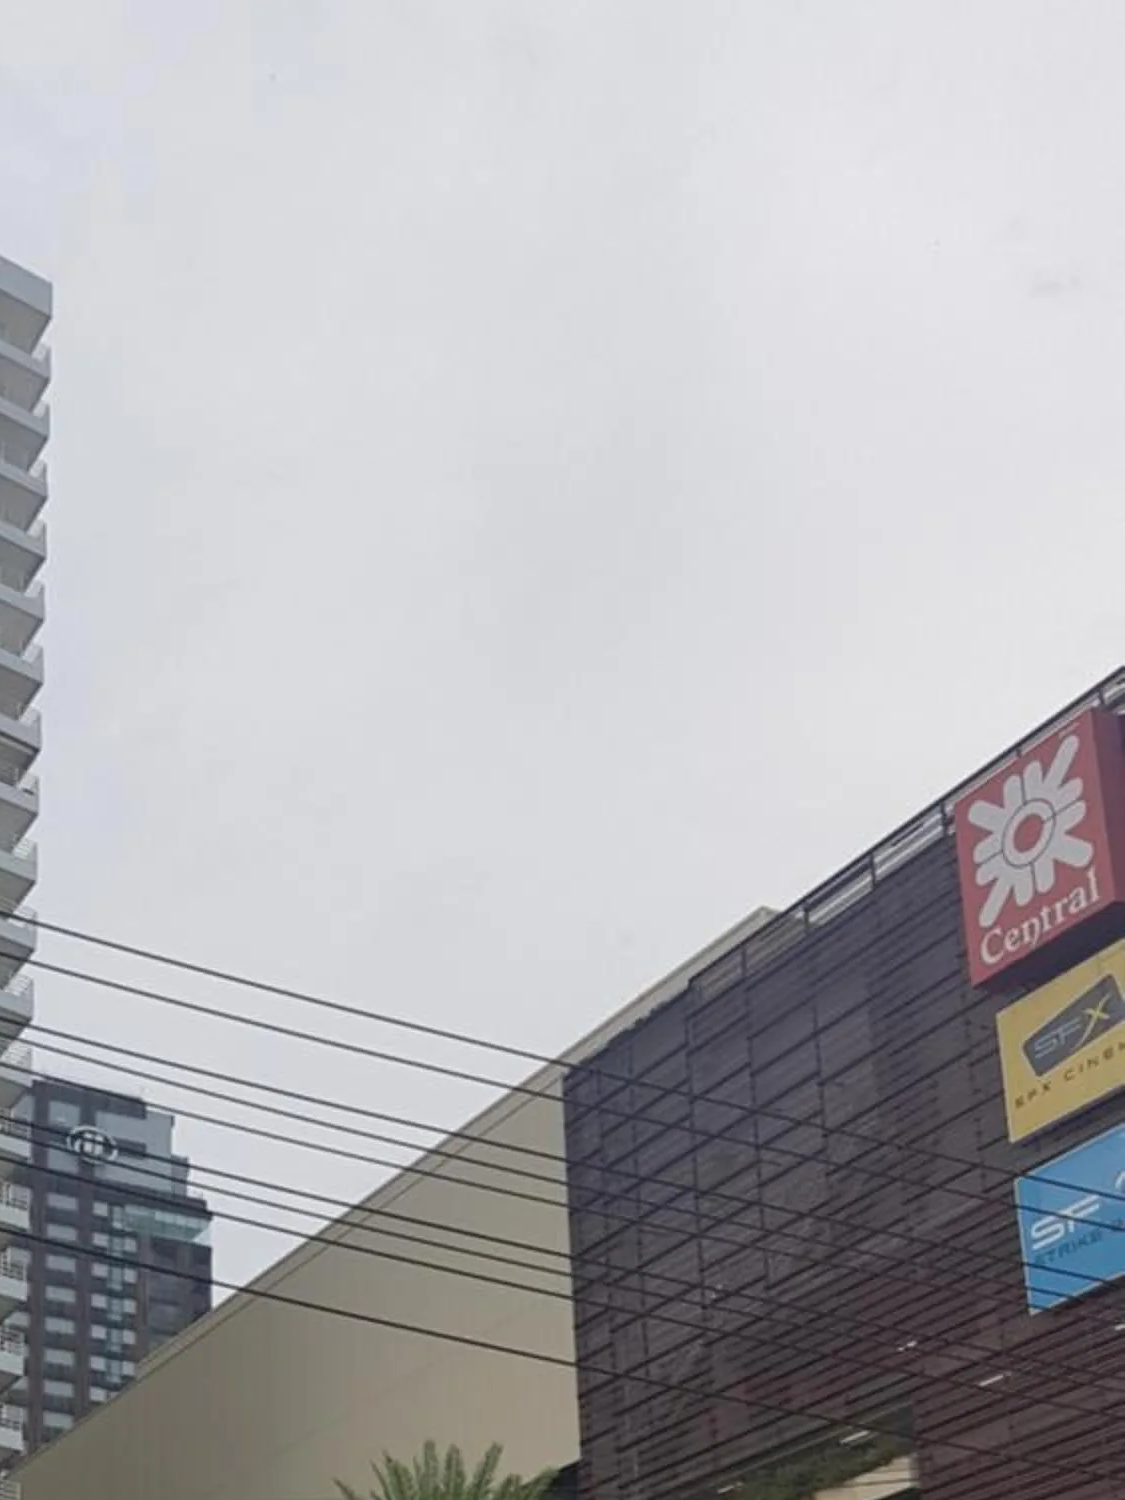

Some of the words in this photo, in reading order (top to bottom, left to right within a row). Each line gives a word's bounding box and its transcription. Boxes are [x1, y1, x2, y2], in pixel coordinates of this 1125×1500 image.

[981, 866, 1100, 965] Central
[1033, 990, 1114, 1059] SFX
[1063, 1041, 1125, 1083] CINE
[1031, 1194, 1100, 1251] SF
